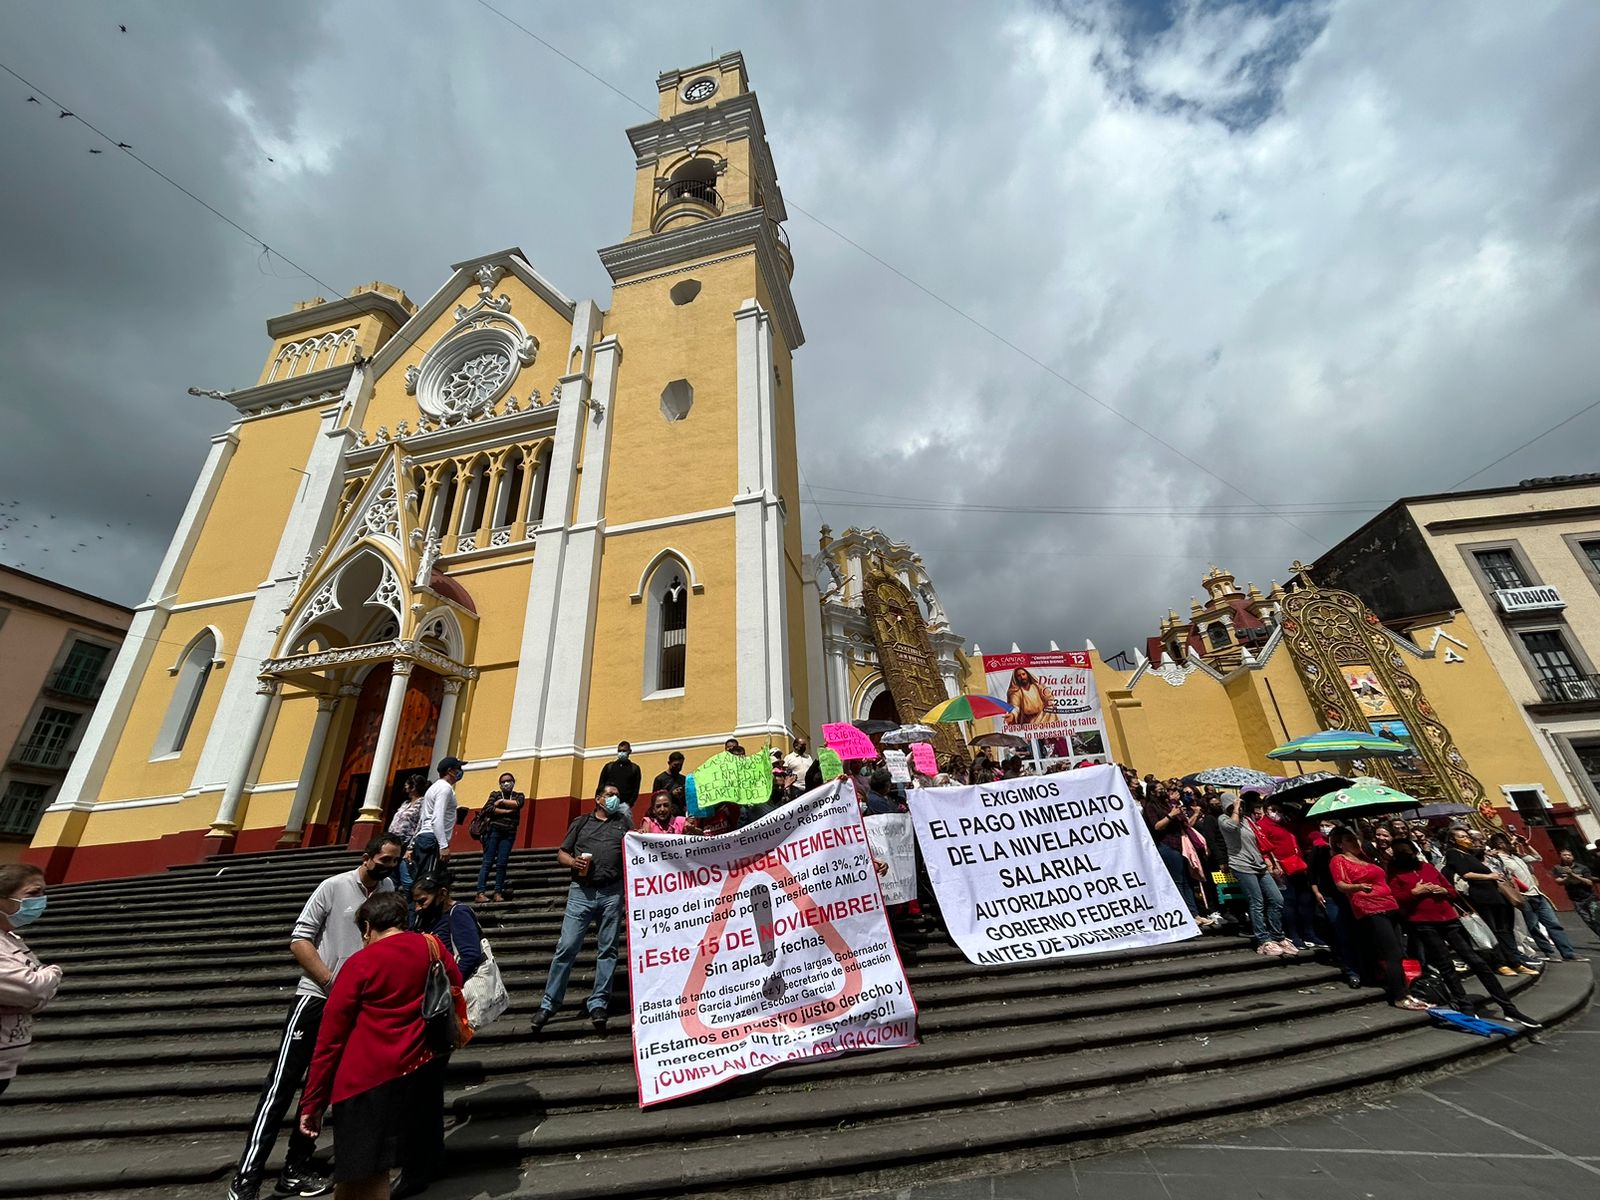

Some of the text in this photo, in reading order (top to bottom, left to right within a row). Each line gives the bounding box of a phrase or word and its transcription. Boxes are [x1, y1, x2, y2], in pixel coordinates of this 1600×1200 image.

[1499, 589, 1560, 606] TRIBUNA
[1039, 674, 1086, 685] Día de la
[1072, 655, 1086, 664] 12
[1042, 686, 1087, 697] Caridad
[1053, 698, 1079, 707] 2022
[1022, 723, 1038, 732] que
[1045, 720, 1068, 729] nadie
[1069, 717, 1077, 726] le
[1078, 717, 1097, 726] falte
[1024, 728, 1076, 740] lo necesario!
[980, 782, 1060, 807] EXIGIMOS
[641, 835, 687, 850] Personal
[788, 808, 795, 818] y
[797, 803, 810, 814] de
[812, 793, 841, 809] apoyo
[929, 820, 958, 840] EL
[959, 812, 1015, 836] PAGO
[1018, 794, 1124, 828] INMEDIATO
[631, 855, 645, 865] de
[648, 853, 658, 862] la
[661, 850, 682, 860] Esc.
[685, 841, 731, 858] Primaria
[783, 821, 795, 831] C.
[634, 825, 865, 897] EXIGIMOS URGENTEMENTE
[947, 817, 1130, 866] DE LA NIVELACIÓN
[633, 853, 870, 921] El pago del incremento salarial del 3%, 2%
[999, 854, 1101, 888] SALARIAL
[641, 926, 648, 938] y
[652, 921, 671, 934] 1%
[674, 908, 736, 930] anunciado
[739, 902, 759, 918] por
[761, 897, 772, 909] el
[775, 881, 832, 908] presidente
[835, 869, 867, 887] AMLO
[976, 872, 1146, 921] AUTORIZADO POR EL
[985, 894, 1154, 941] GOBIERNO FEDERAL
[639, 945, 690, 974] ¡Este
[697, 937, 720, 957] 15
[725, 928, 756, 951] DE
[759, 892, 880, 942] NOVIEMBRE!
[977, 910, 1188, 964] ANTES DE DICIEMBRE 2022
[639, 941, 888, 1014] ¡Basta de tanto discurso y darnos largas Gobernador
[704, 935, 826, 977] Sin aplazar fechas
[639, 953, 892, 1026] Cuitláhuac García Jiménez y secretario de educación
[710, 981, 836, 1025] Zenyazen Escobar García!
[639, 979, 904, 1060] ¡¡Estamos en nuestro justo derecho y
[657, 1040, 748, 1067] merecemos
[751, 1034, 769, 1045] un
[771, 1029, 806, 1046] trao
[653, 1056, 748, 1094] ¡CUMPLAN
